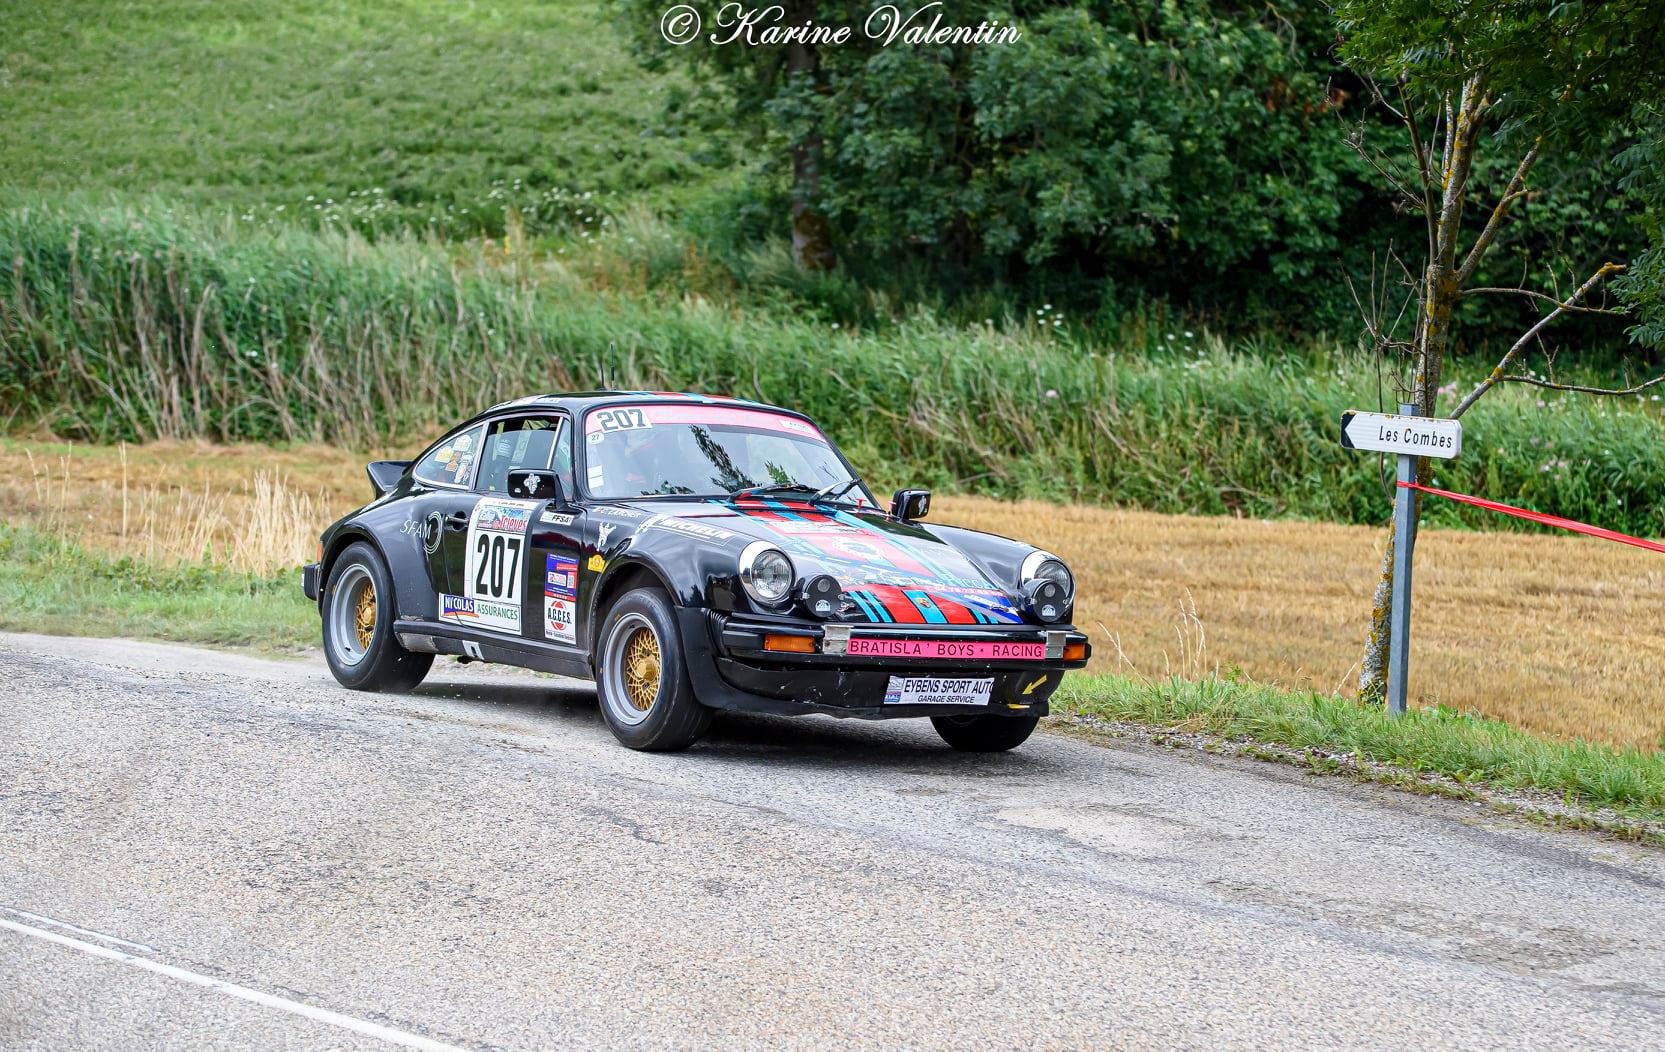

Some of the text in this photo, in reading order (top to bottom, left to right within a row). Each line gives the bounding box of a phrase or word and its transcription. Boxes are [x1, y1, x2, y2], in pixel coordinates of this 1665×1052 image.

[596, 408, 646, 431] 207
[1379, 425, 1452, 448] Les Combes
[551, 514, 569, 523] FFSA
[475, 533, 521, 599] 207
[477, 603, 518, 620] ASSURANCES
[937, 643, 974, 656] BOYS
[992, 644, 1042, 657] RACING
[904, 680, 940, 693] EYBENS
[941, 680, 972, 694] SPORT
[917, 694, 975, 703] GARAGE SERVICE
